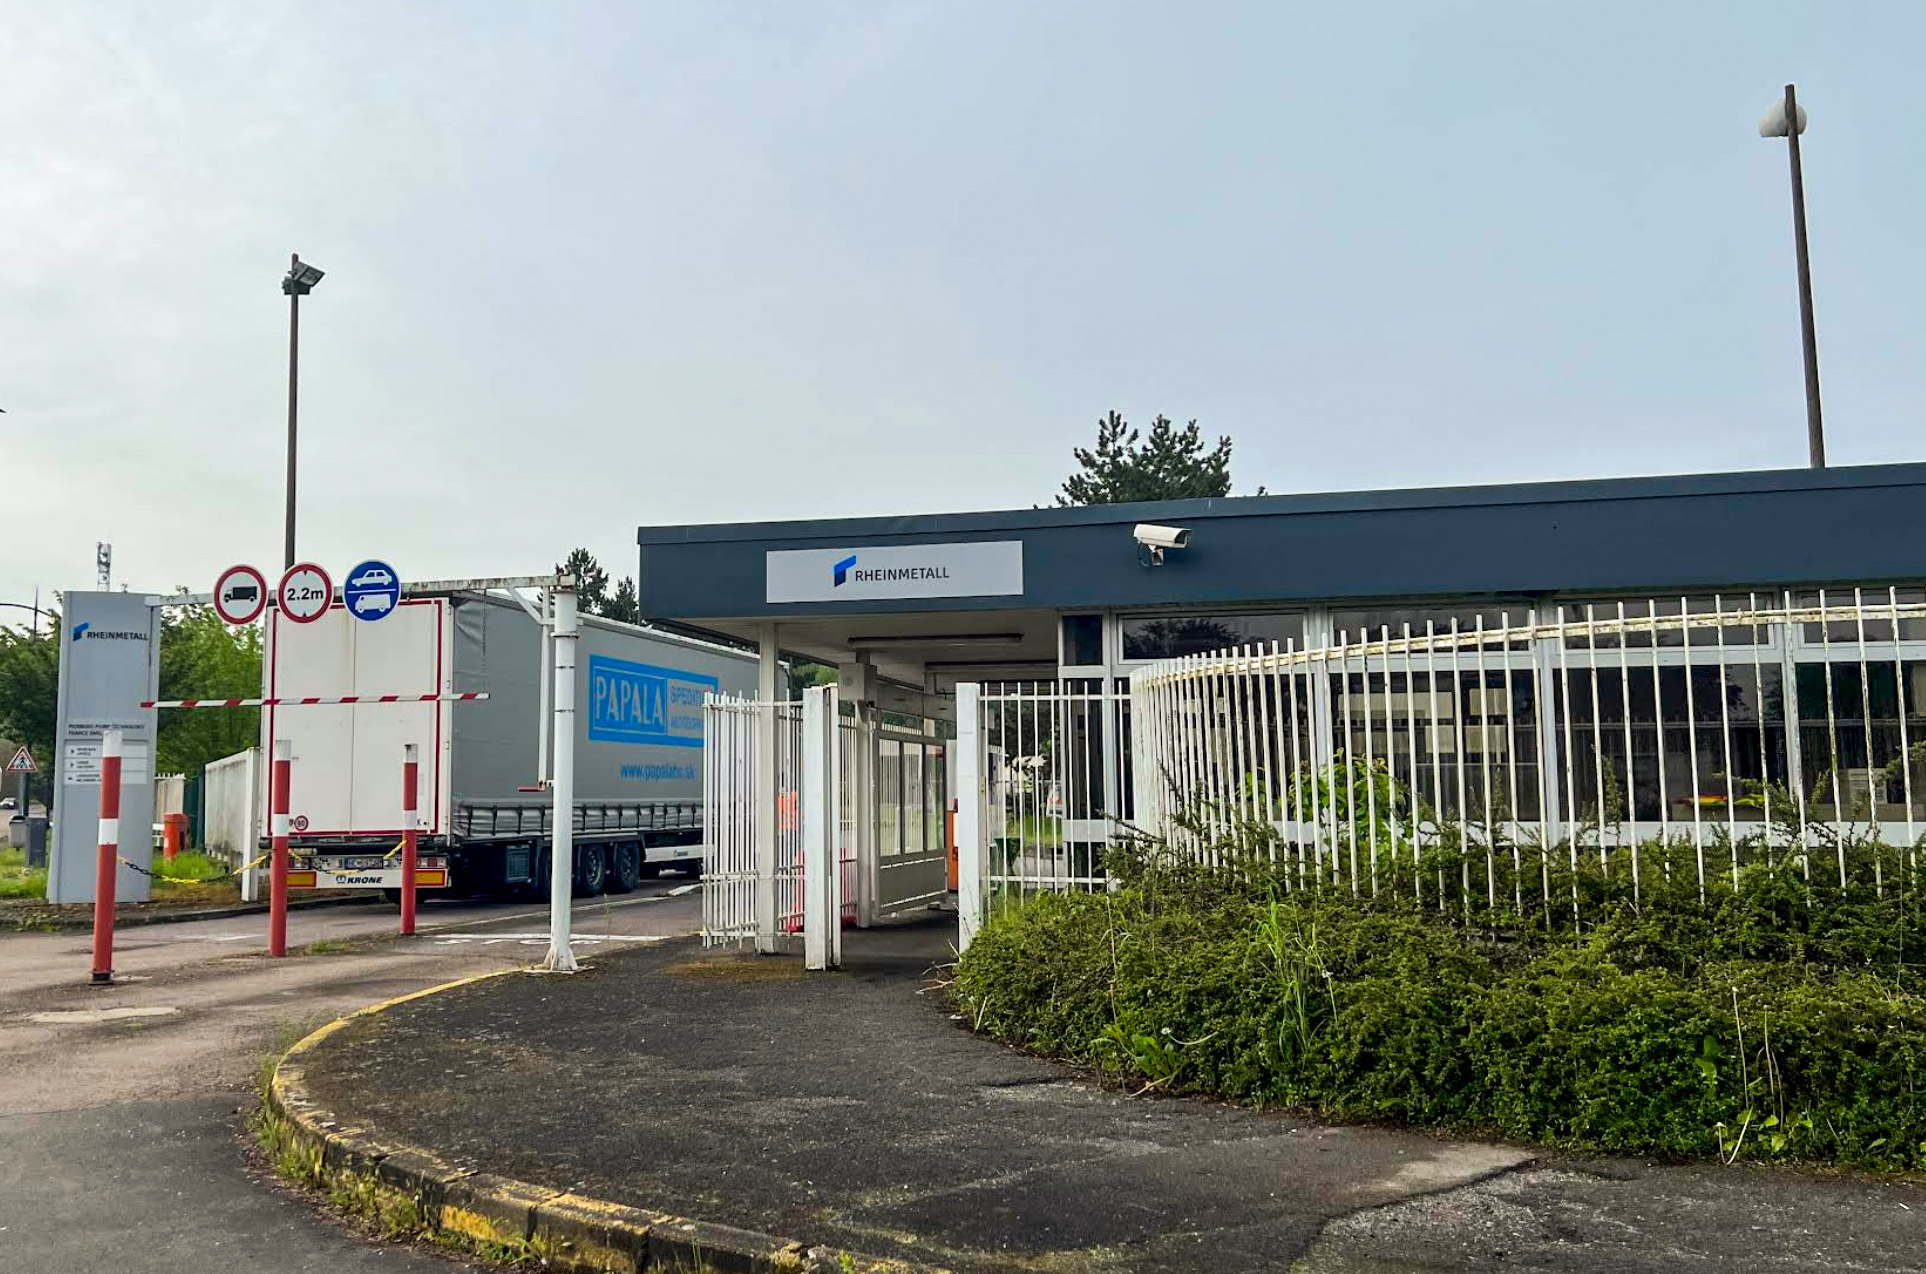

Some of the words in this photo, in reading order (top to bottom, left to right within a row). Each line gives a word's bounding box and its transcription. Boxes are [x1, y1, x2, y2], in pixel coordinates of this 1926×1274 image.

[855, 566, 950, 582] RHEINMETALL
[287, 587, 324, 601] 2.2m
[87, 631, 149, 641] RHEINMETALL
[595, 676, 664, 726] PAPALA
[347, 876, 383, 884] KRONE
